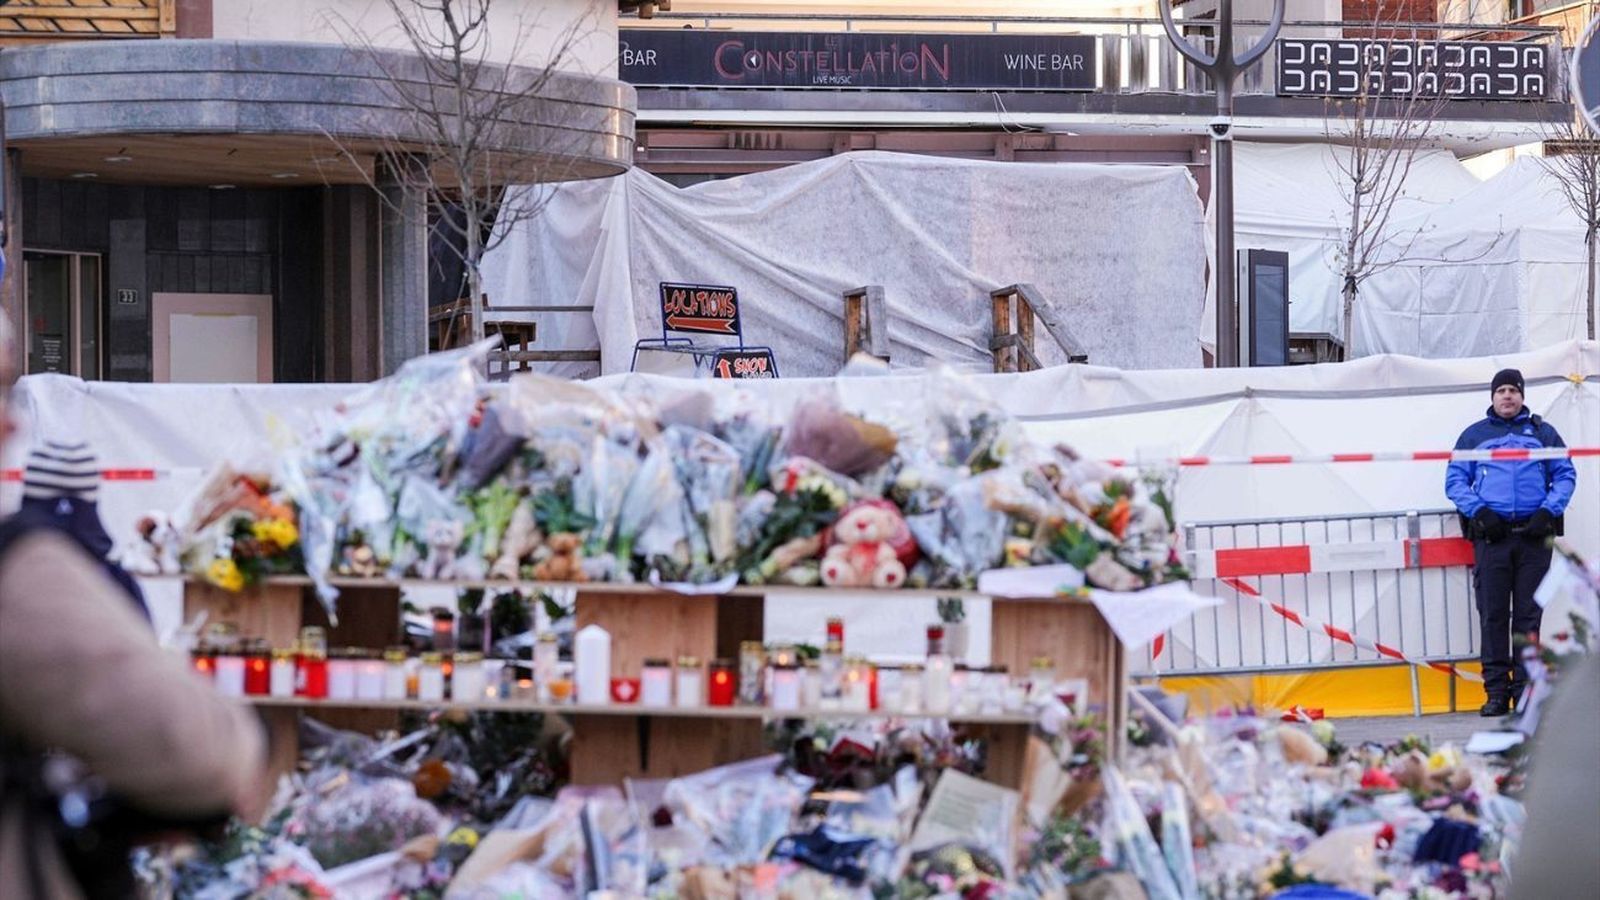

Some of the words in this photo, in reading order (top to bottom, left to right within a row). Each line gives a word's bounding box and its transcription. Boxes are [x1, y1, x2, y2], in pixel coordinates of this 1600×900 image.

[623, 50, 657, 66] BAR
[1004, 54, 1047, 70] WINE
[1051, 54, 1084, 70] BAR
[813, 75, 828, 84] LIVE
[829, 75, 852, 84] MUSIC
[664, 289, 736, 318] LOCATIONS
[734, 357, 767, 374] SNOW
